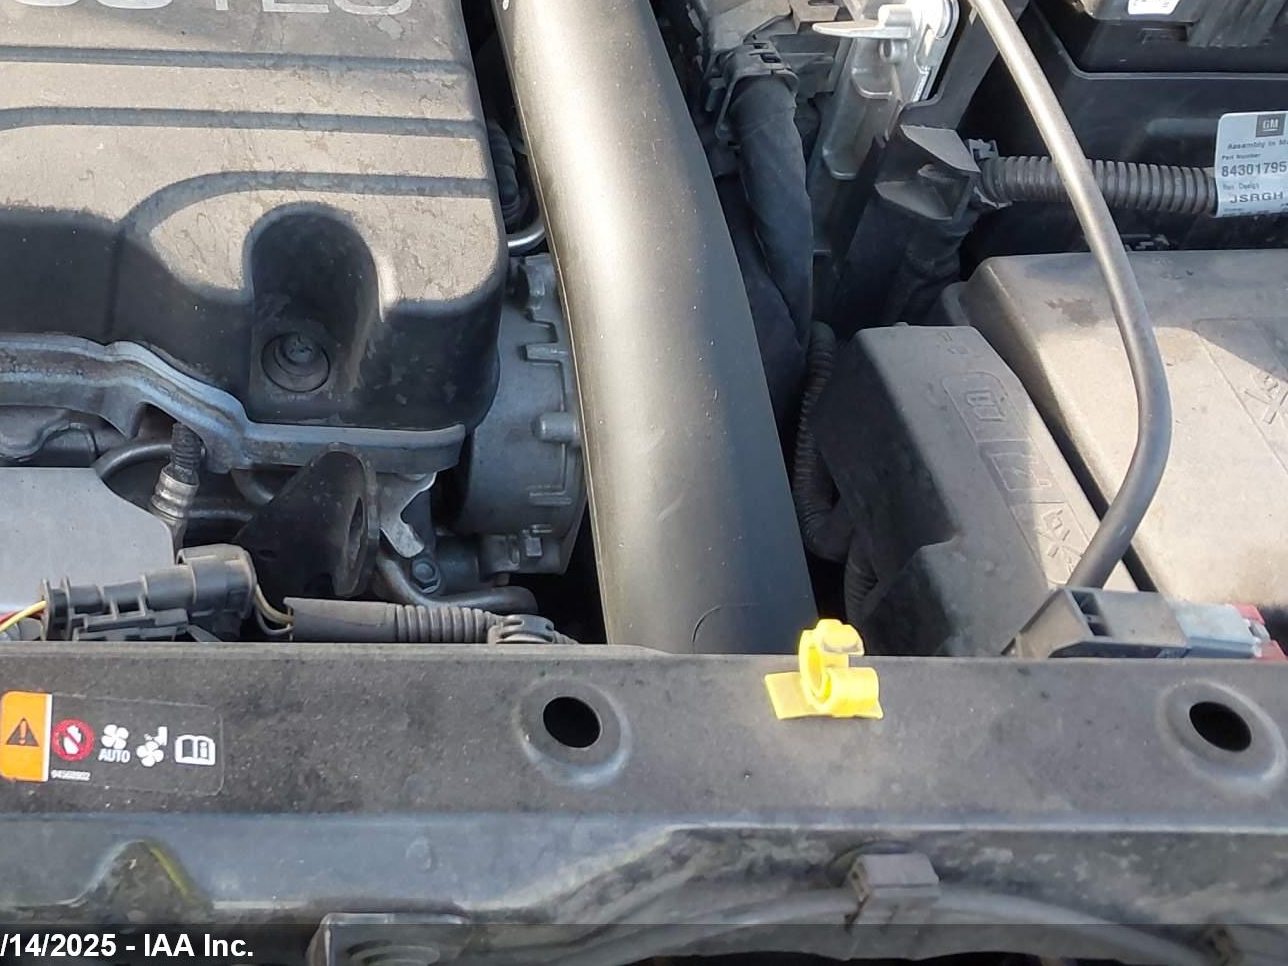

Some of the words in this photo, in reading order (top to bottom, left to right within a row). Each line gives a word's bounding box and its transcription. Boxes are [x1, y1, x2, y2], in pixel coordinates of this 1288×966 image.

[1262, 118, 1279, 130] GM
[1221, 161, 1287, 177] 84301795
[98, 749, 130, 763] AUTO
